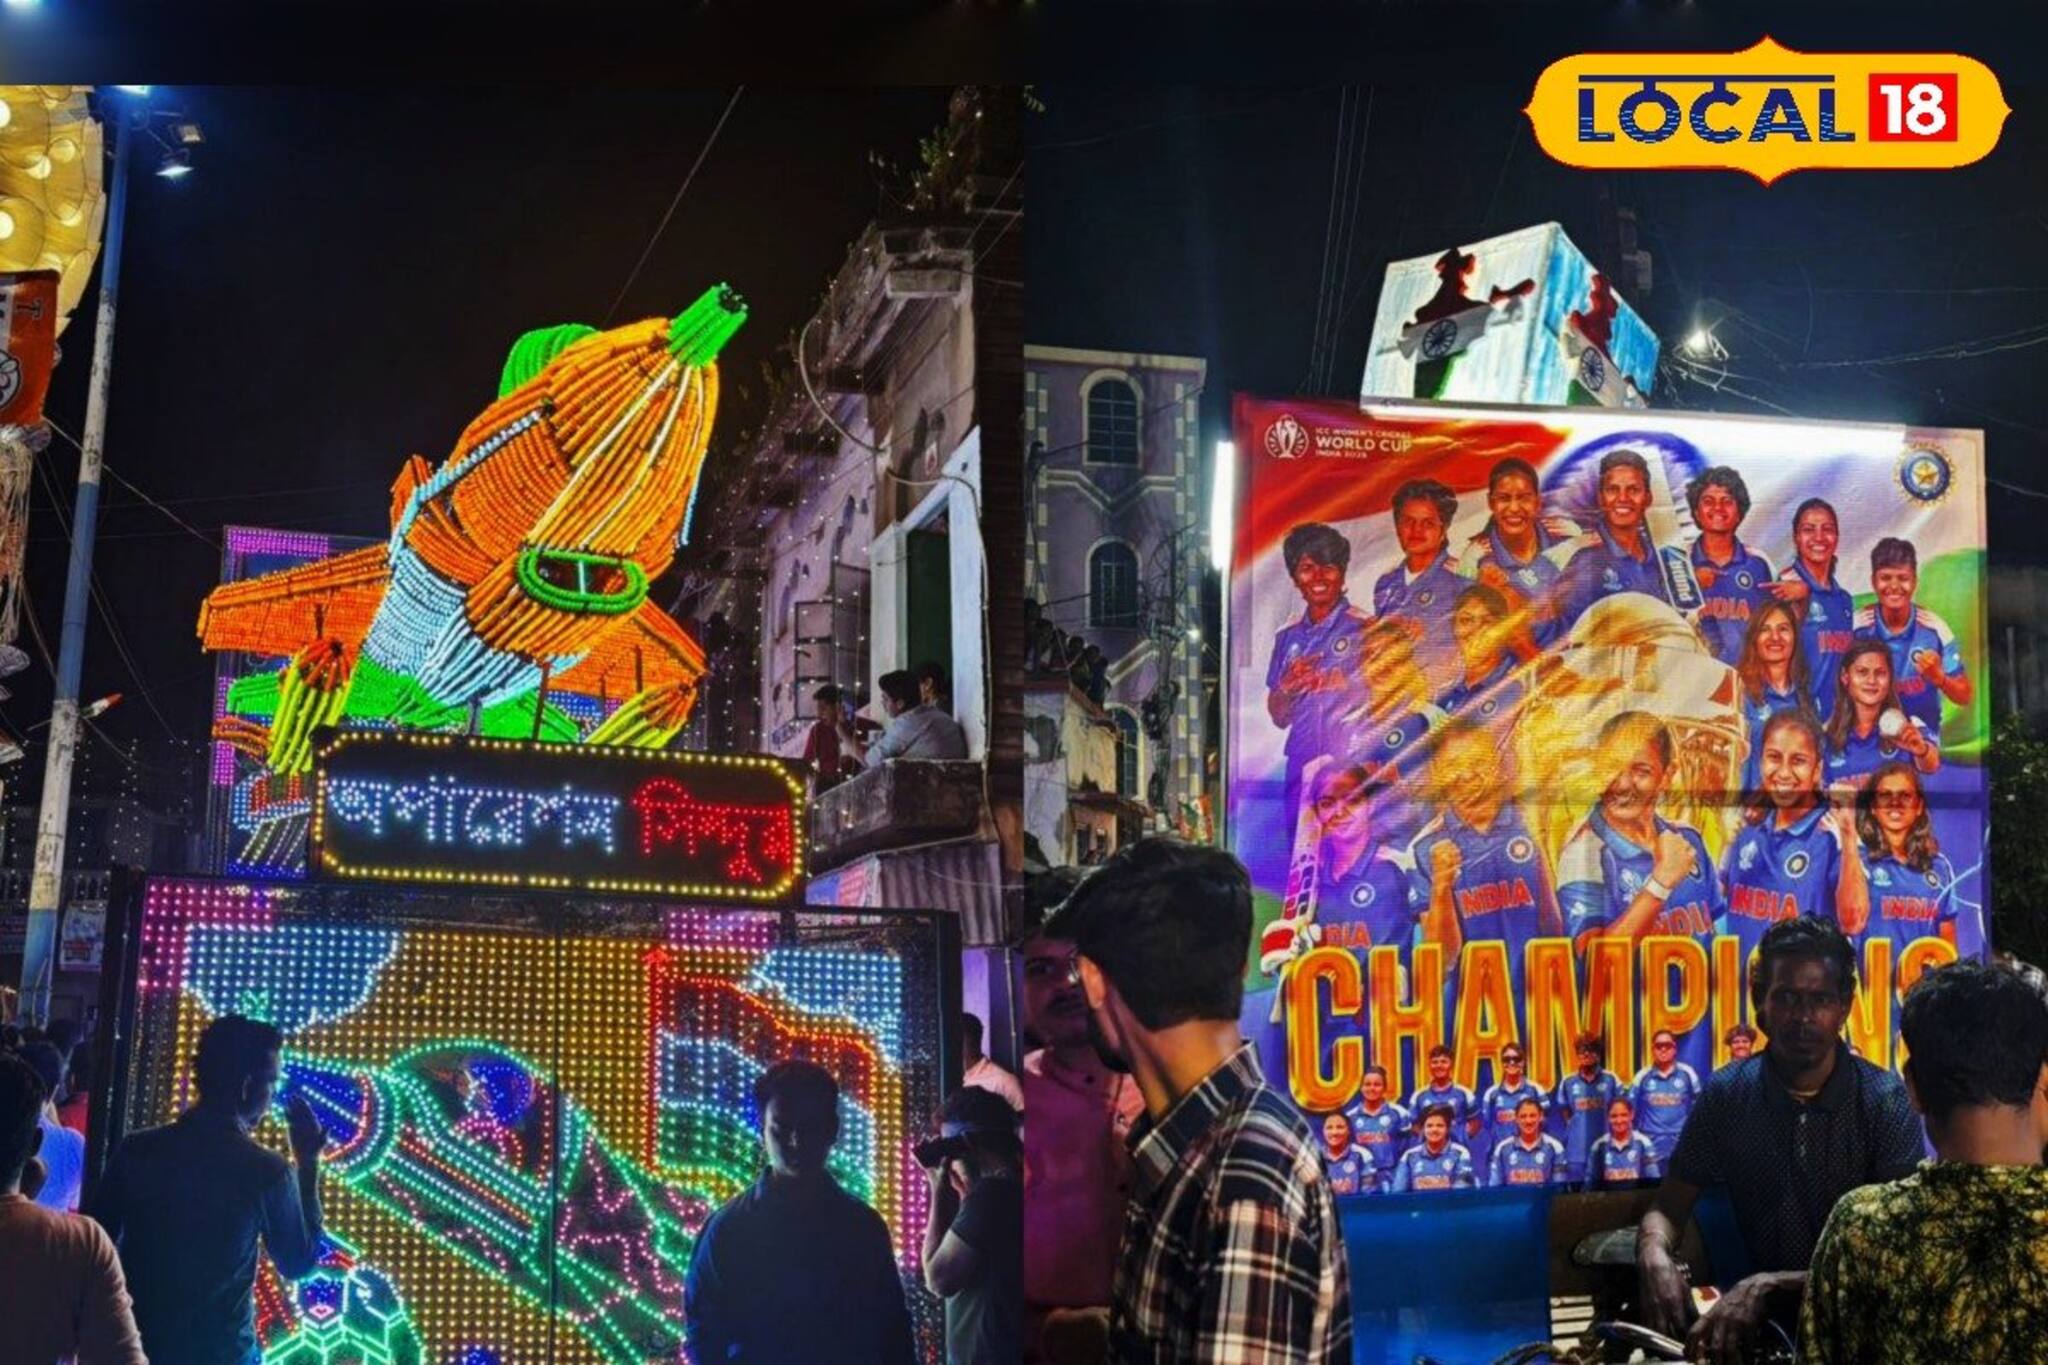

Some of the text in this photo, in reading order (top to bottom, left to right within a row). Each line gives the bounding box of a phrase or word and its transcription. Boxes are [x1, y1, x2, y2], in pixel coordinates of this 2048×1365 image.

[1316, 436, 1413, 453] WORLD CUP
[1287, 935, 1960, 1113] CHAMPIN
